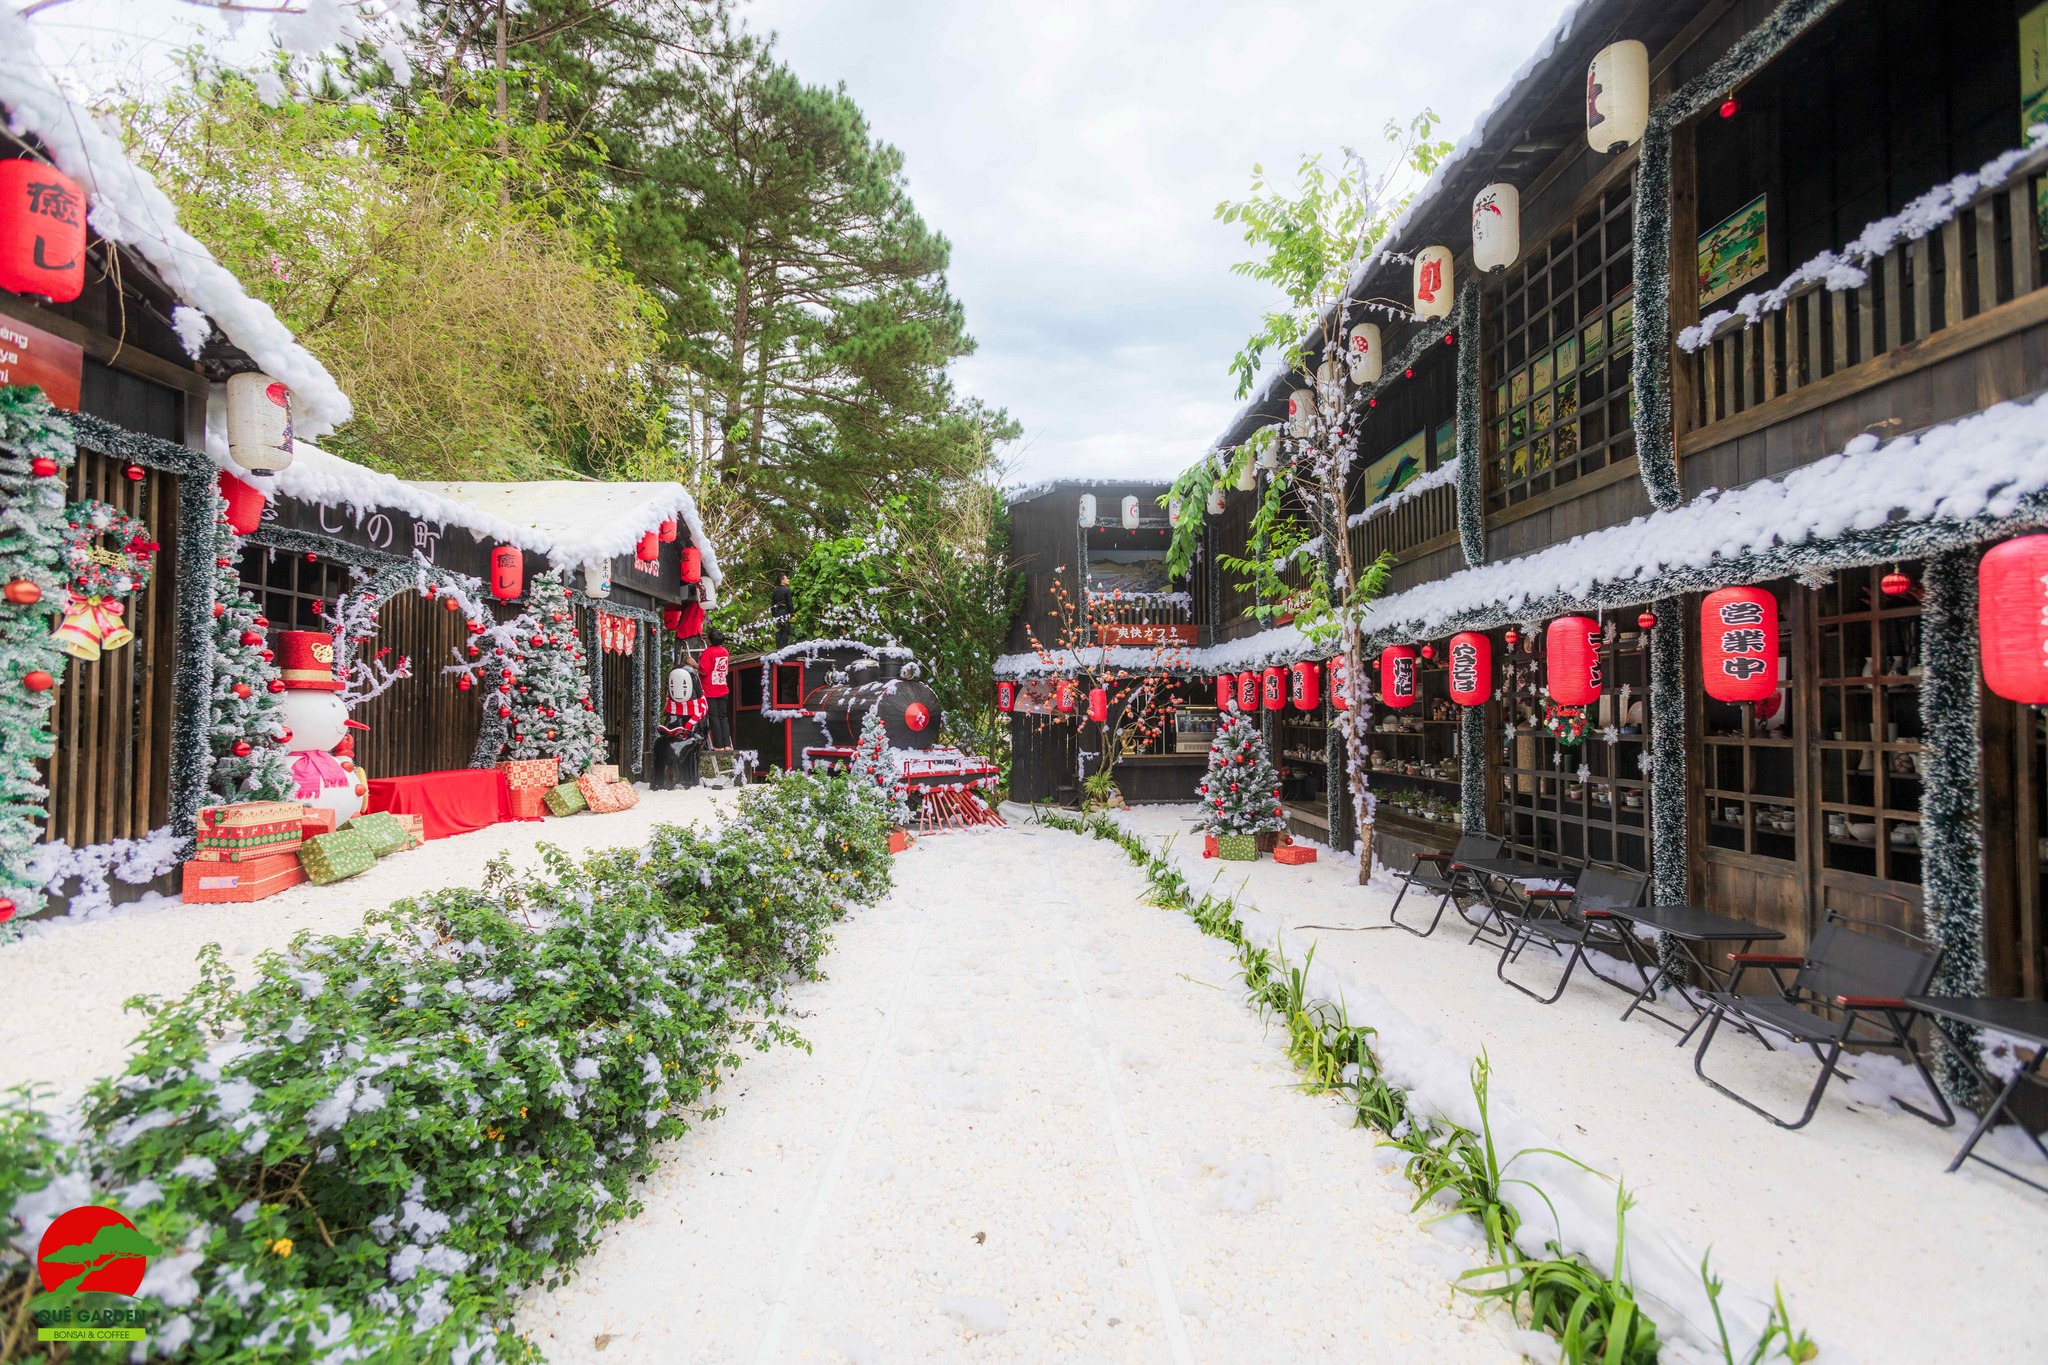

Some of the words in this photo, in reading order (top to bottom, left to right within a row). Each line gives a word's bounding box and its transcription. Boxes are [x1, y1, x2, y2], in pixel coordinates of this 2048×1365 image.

[1720, 602, 1766, 680] 営業中
[1266, 675, 1279, 700] 寿司
